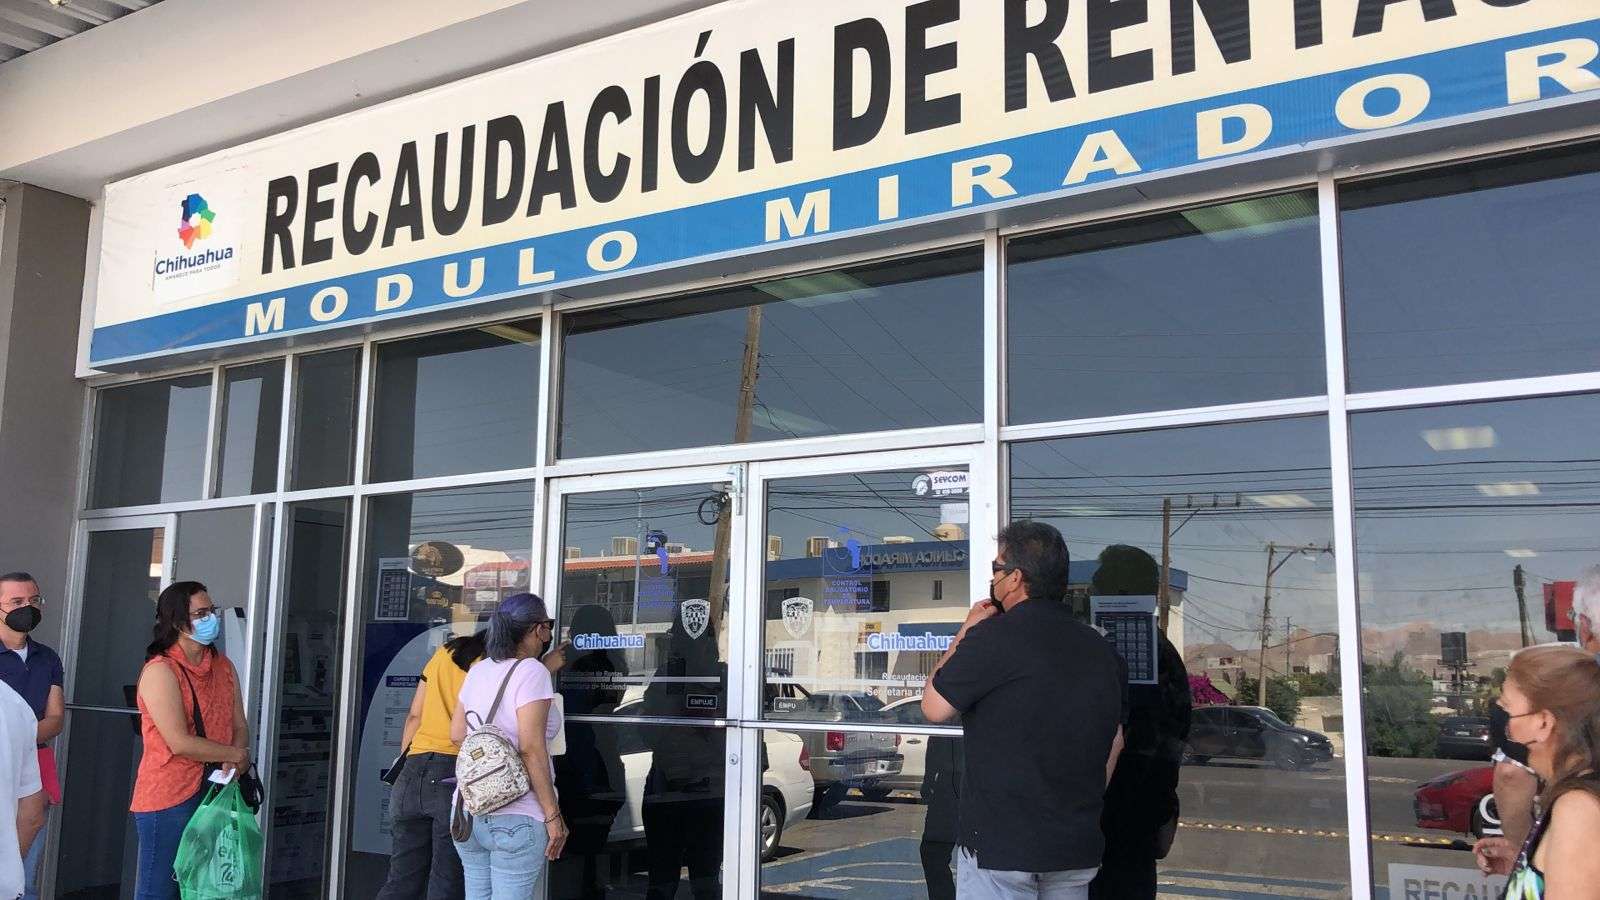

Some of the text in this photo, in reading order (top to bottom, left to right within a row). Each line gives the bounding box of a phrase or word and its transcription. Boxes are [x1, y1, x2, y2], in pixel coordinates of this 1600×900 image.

[261, 30, 796, 275] RECAUDACIÓN
[832, 0, 962, 152] DE
[244, 38, 1600, 336] MODULO MIRADOR
[155, 247, 233, 275] Chihuahua
[574, 633, 645, 649] Chihuahua
[868, 632, 953, 650] Chihuahu
[882, 672, 929, 681] Rcaudació
[601, 682, 628, 691] Haciend
